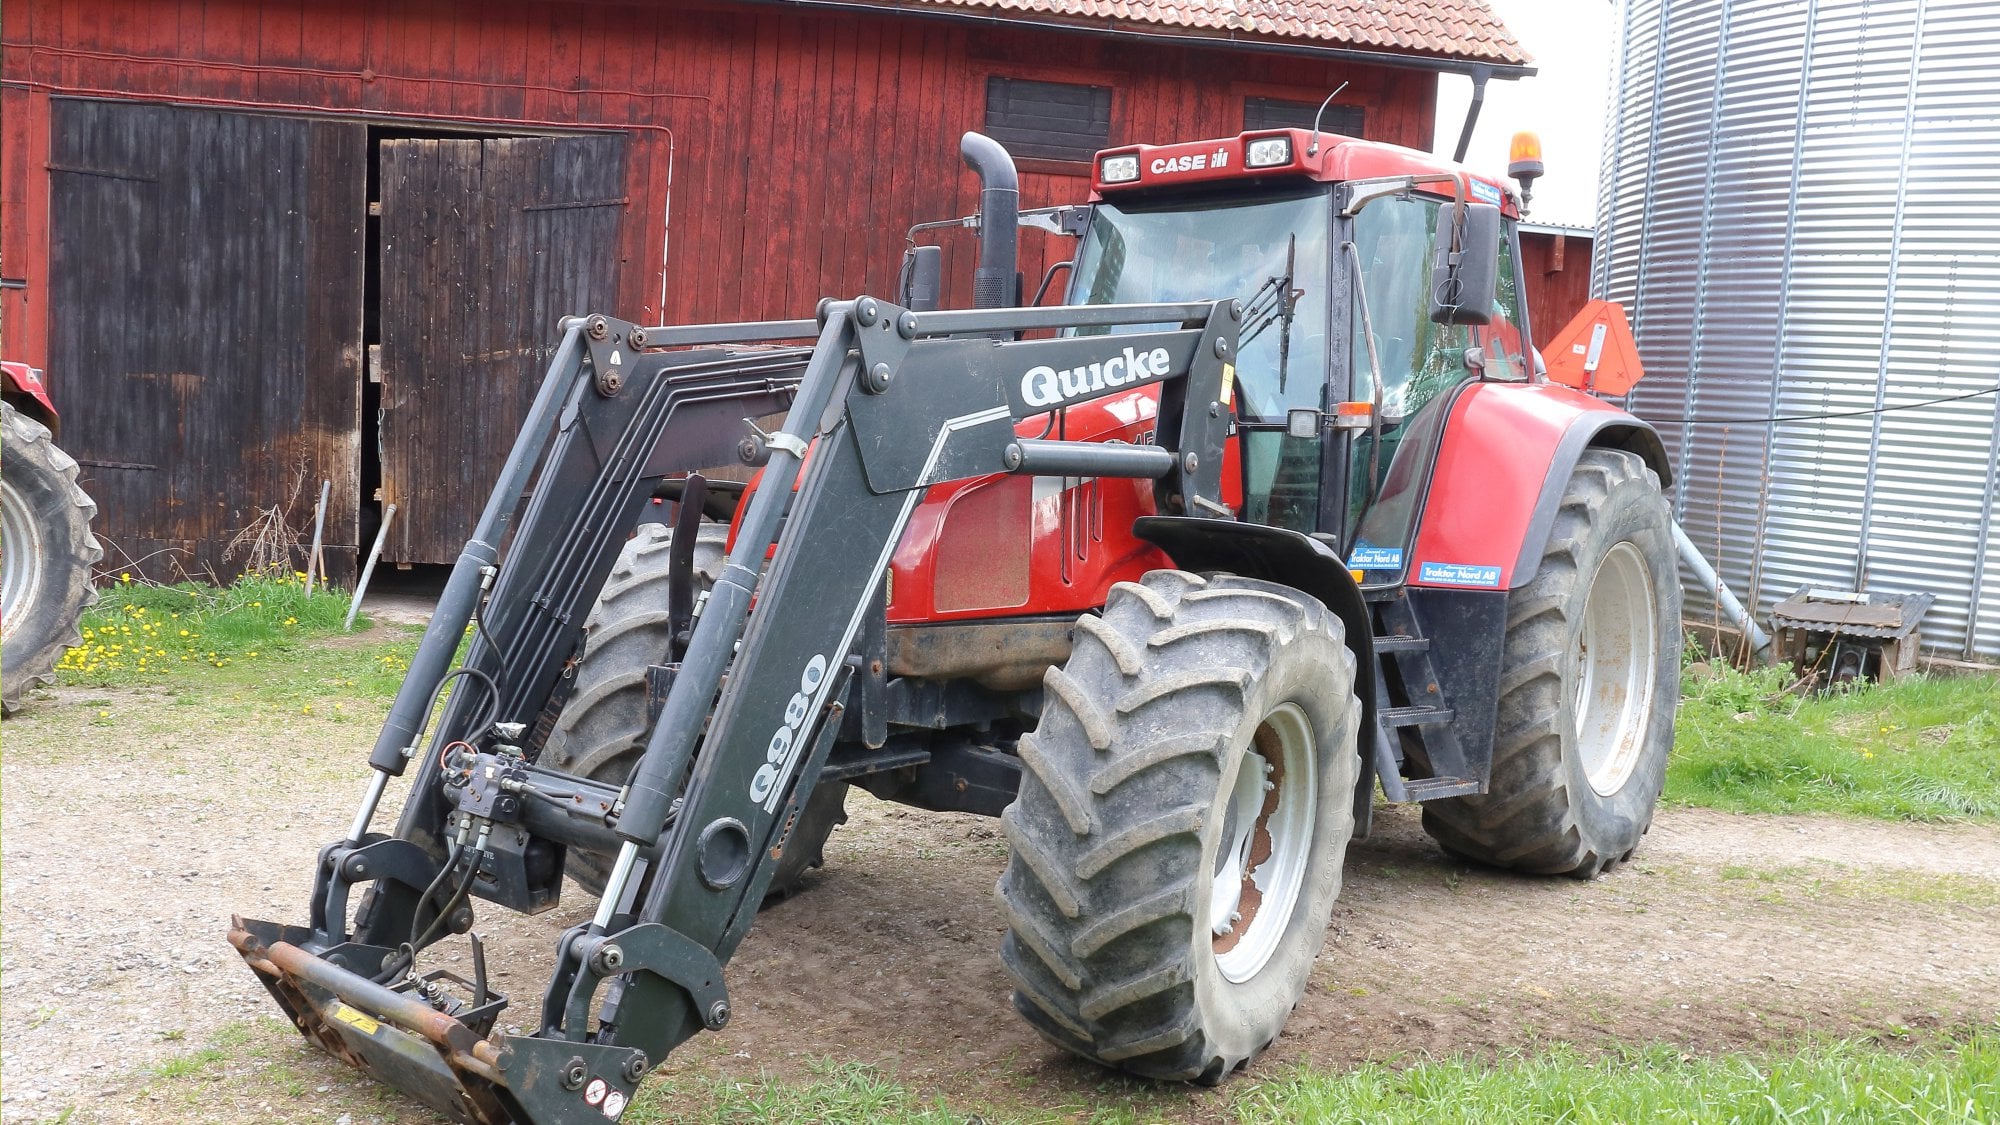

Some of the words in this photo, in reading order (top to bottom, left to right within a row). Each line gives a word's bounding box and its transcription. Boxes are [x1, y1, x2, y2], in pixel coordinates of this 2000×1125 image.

[1151, 154, 1207, 174] CASE
[1020, 346, 1170, 407] Quicke
[1350, 553, 1373, 563] Traktor
[1374, 553, 1391, 563] Nord
[1391, 554, 1400, 563] AB
[1425, 567, 1456, 578] Traktor
[1457, 569, 1482, 580] Nord
[1482, 570, 1496, 580] AB
[750, 654, 826, 803] Q980
